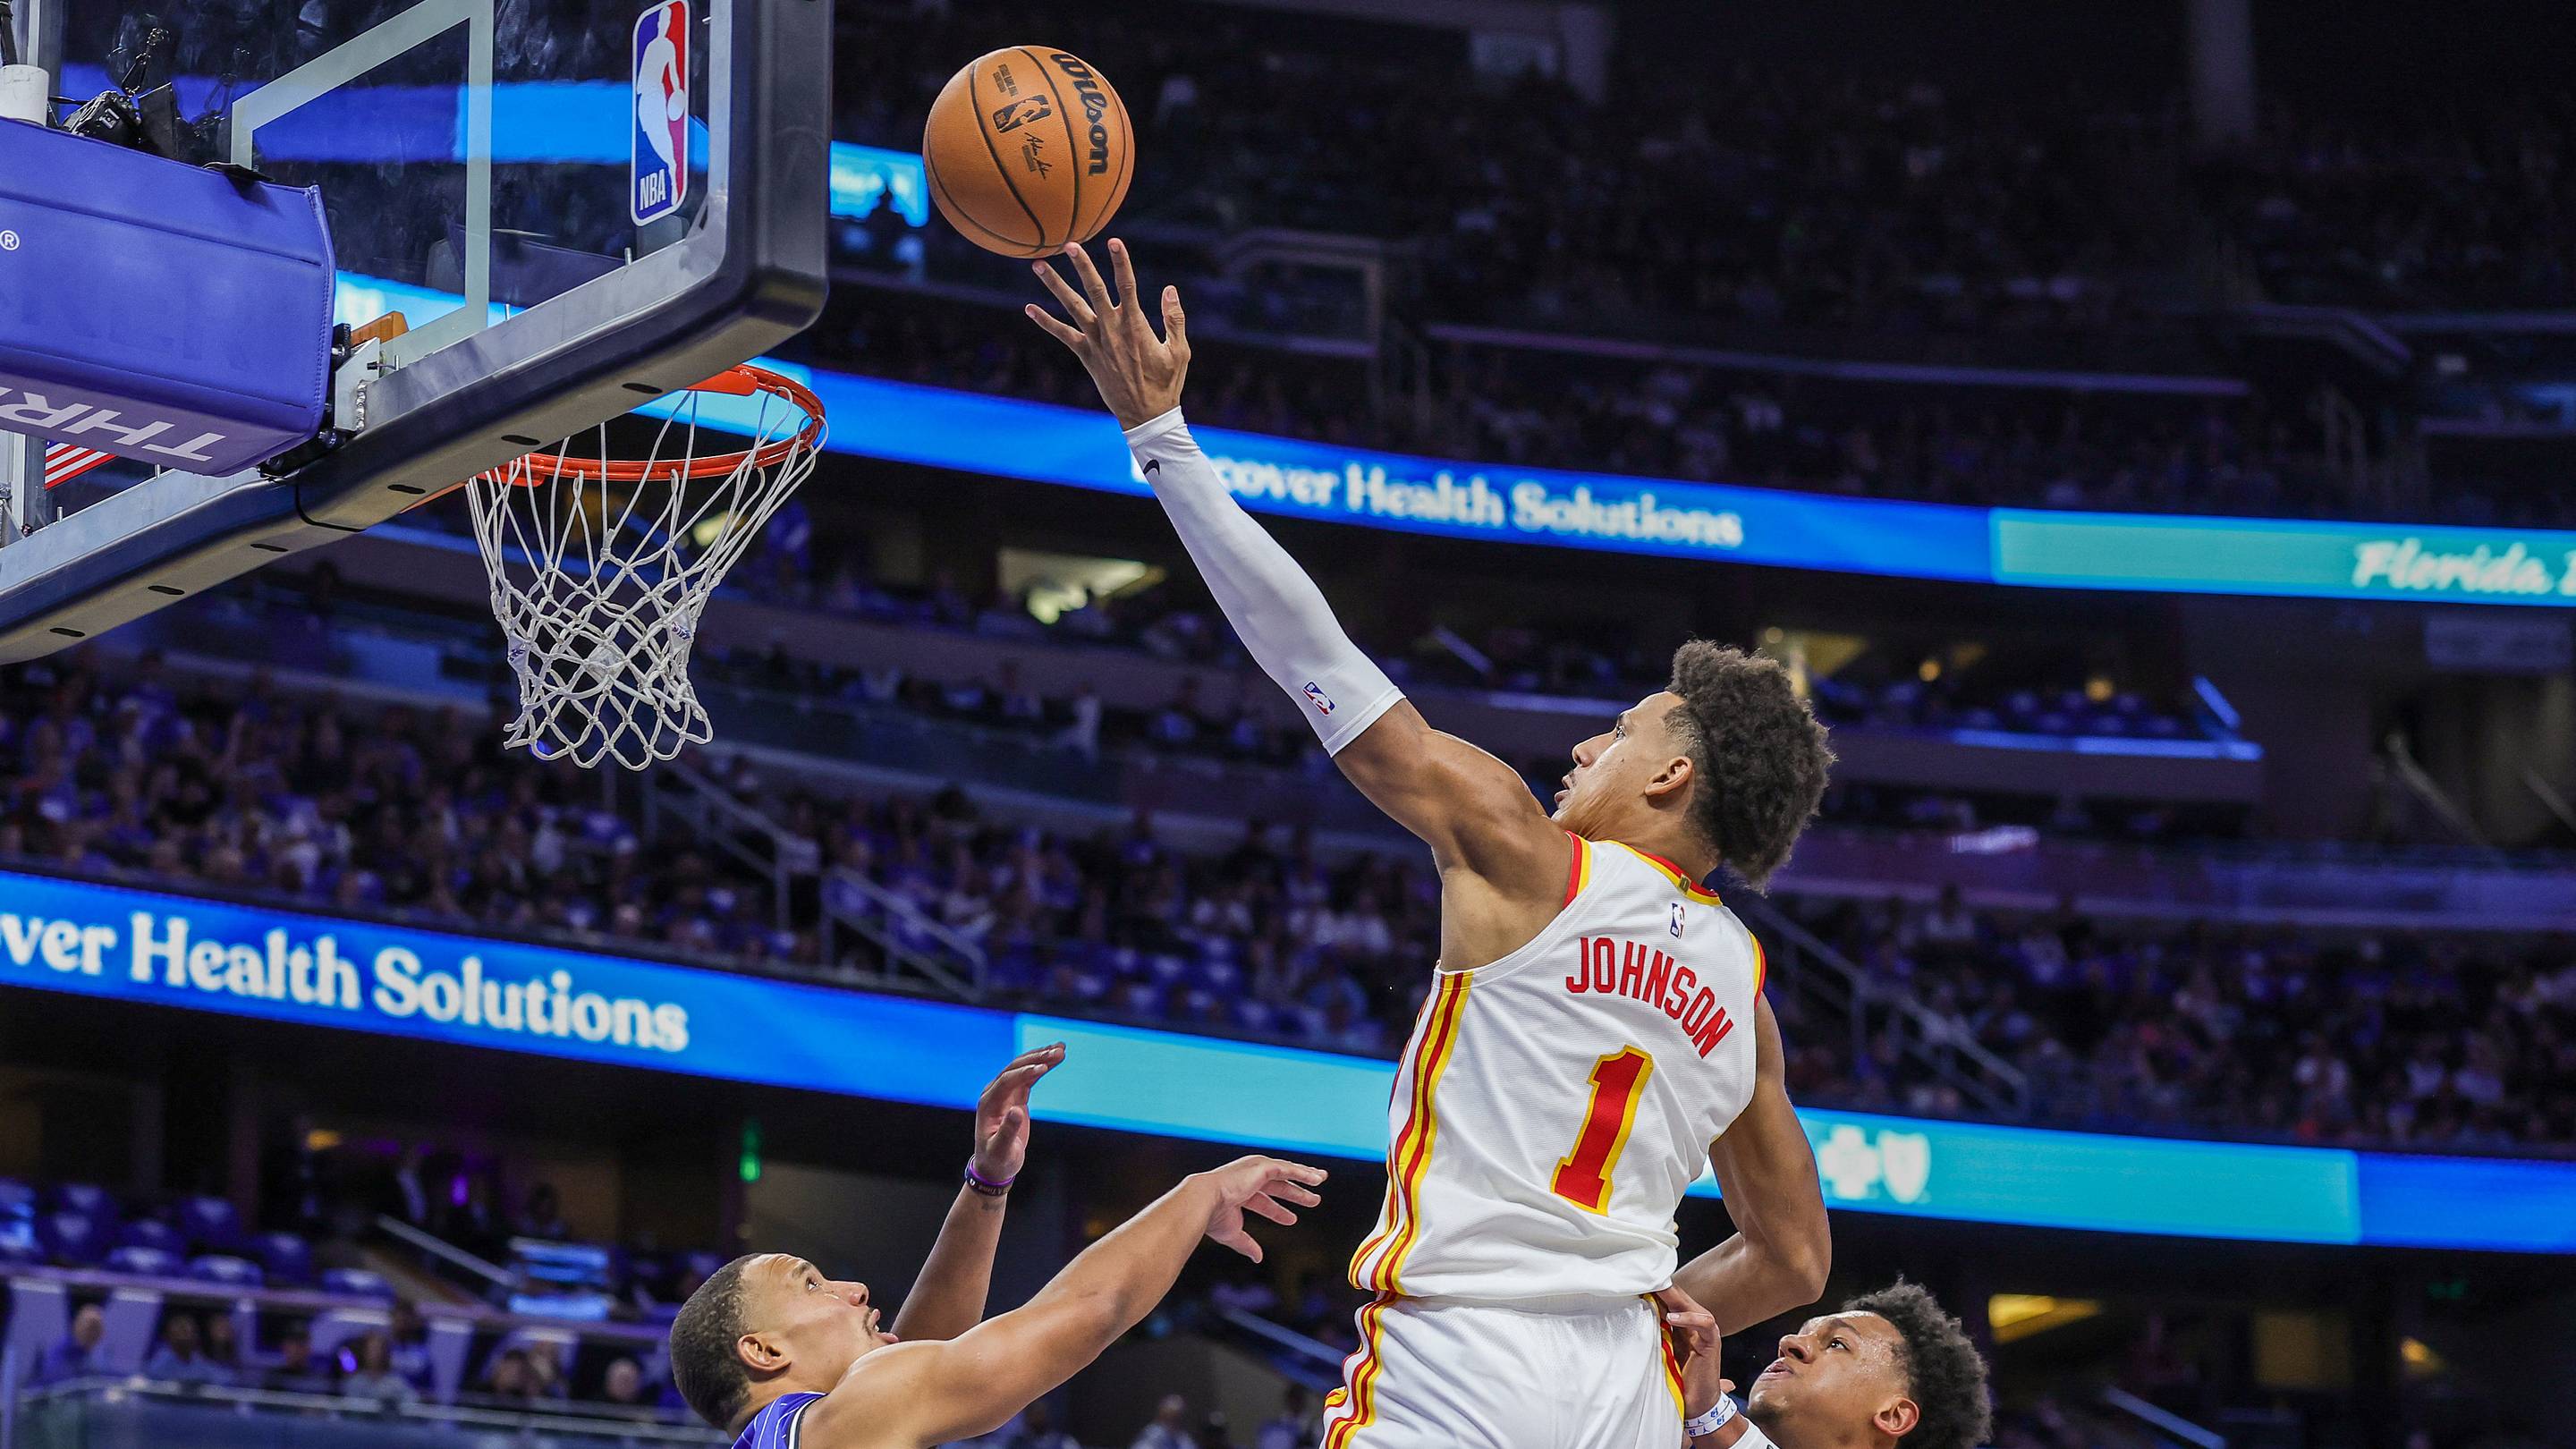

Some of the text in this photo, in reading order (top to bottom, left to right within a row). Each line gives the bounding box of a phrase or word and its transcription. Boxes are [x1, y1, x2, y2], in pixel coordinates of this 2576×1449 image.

[1050, 54, 1109, 176] Wilson
[640, 168, 666, 211] NBA
[0, 386, 226, 462] THR
[1131, 451, 1744, 548] cover Health Solutions
[2351, 538, 2554, 595] Florida
[0, 911, 691, 1053] ver Health Solutions
[1565, 936, 1733, 1060] JOHNSON
[1550, 1044, 1654, 1217] 1
